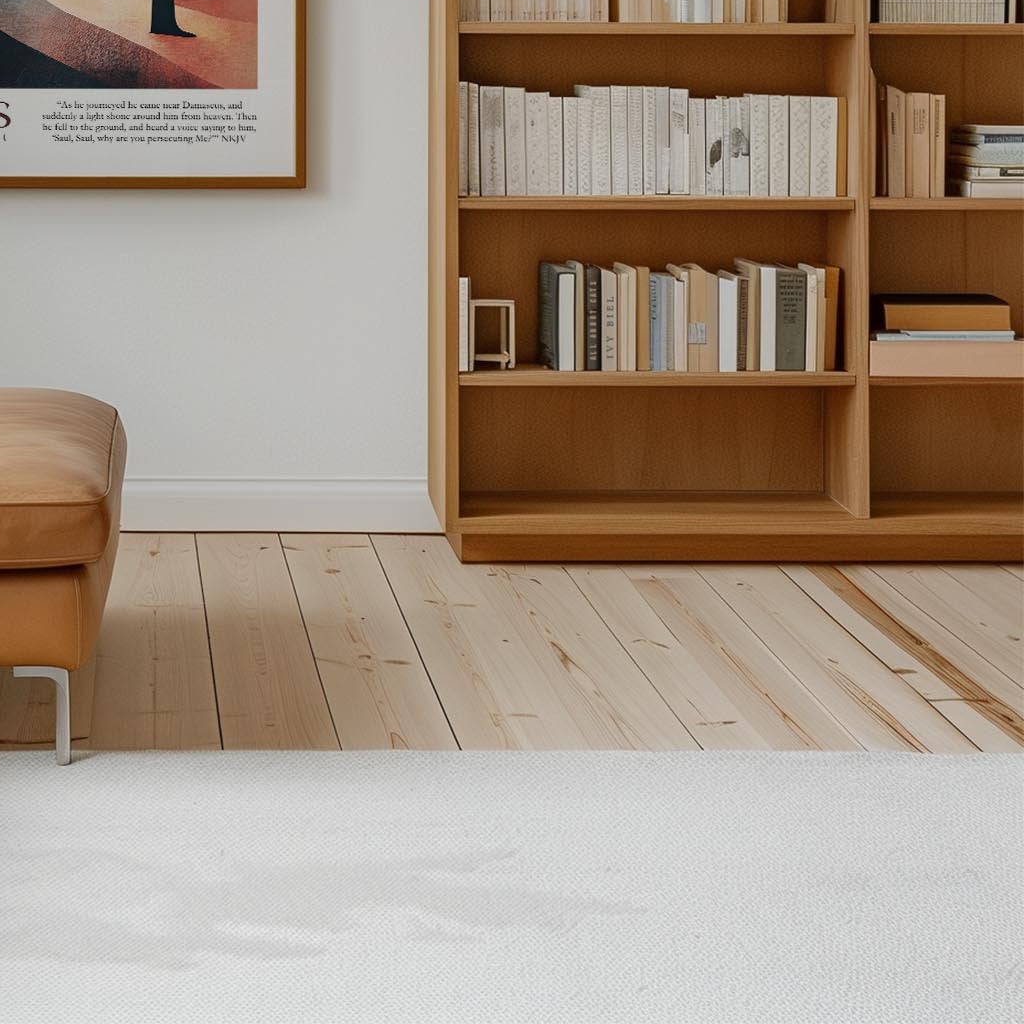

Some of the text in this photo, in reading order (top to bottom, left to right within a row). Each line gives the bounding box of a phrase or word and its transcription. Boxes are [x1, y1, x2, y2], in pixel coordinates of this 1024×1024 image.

[74, 101, 84, 109] he
[86, 101, 126, 111] journeyed
[128, 101, 137, 109] he
[182, 101, 226, 111] Damascus,
[228, 101, 243, 109] and
[42, 112, 77, 122] suddenly
[86, 112, 104, 122] light
[106, 112, 130, 120] shone
[132, 112, 161, 120] around
[163, 112, 179, 120] him
[181, 112, 201, 120] from
[203, 112, 233, 120] heaven.
[236, 112, 258, 120] Then
[42, 123, 52, 131] he
[55, 123, 68, 131] fell
[80, 123, 93, 131] the
[95, 123, 127, 133] ground,
[128, 123, 144, 131] and
[146, 123, 168, 131] heard
[177, 123, 198, 131] voice
[201, 123, 226, 133] saying
[238, 123, 257, 133] him,
[75, 134, 95, 144] Saul,
[97, 134, 113, 144] why
[130, 136, 145, 144] you
[147, 135, 193, 144] persecuting
[221, 134, 247, 144] NKJV
[589, 281, 597, 361] ALL ABOUT CATS
[606, 296, 615, 359] IVY BIEL
